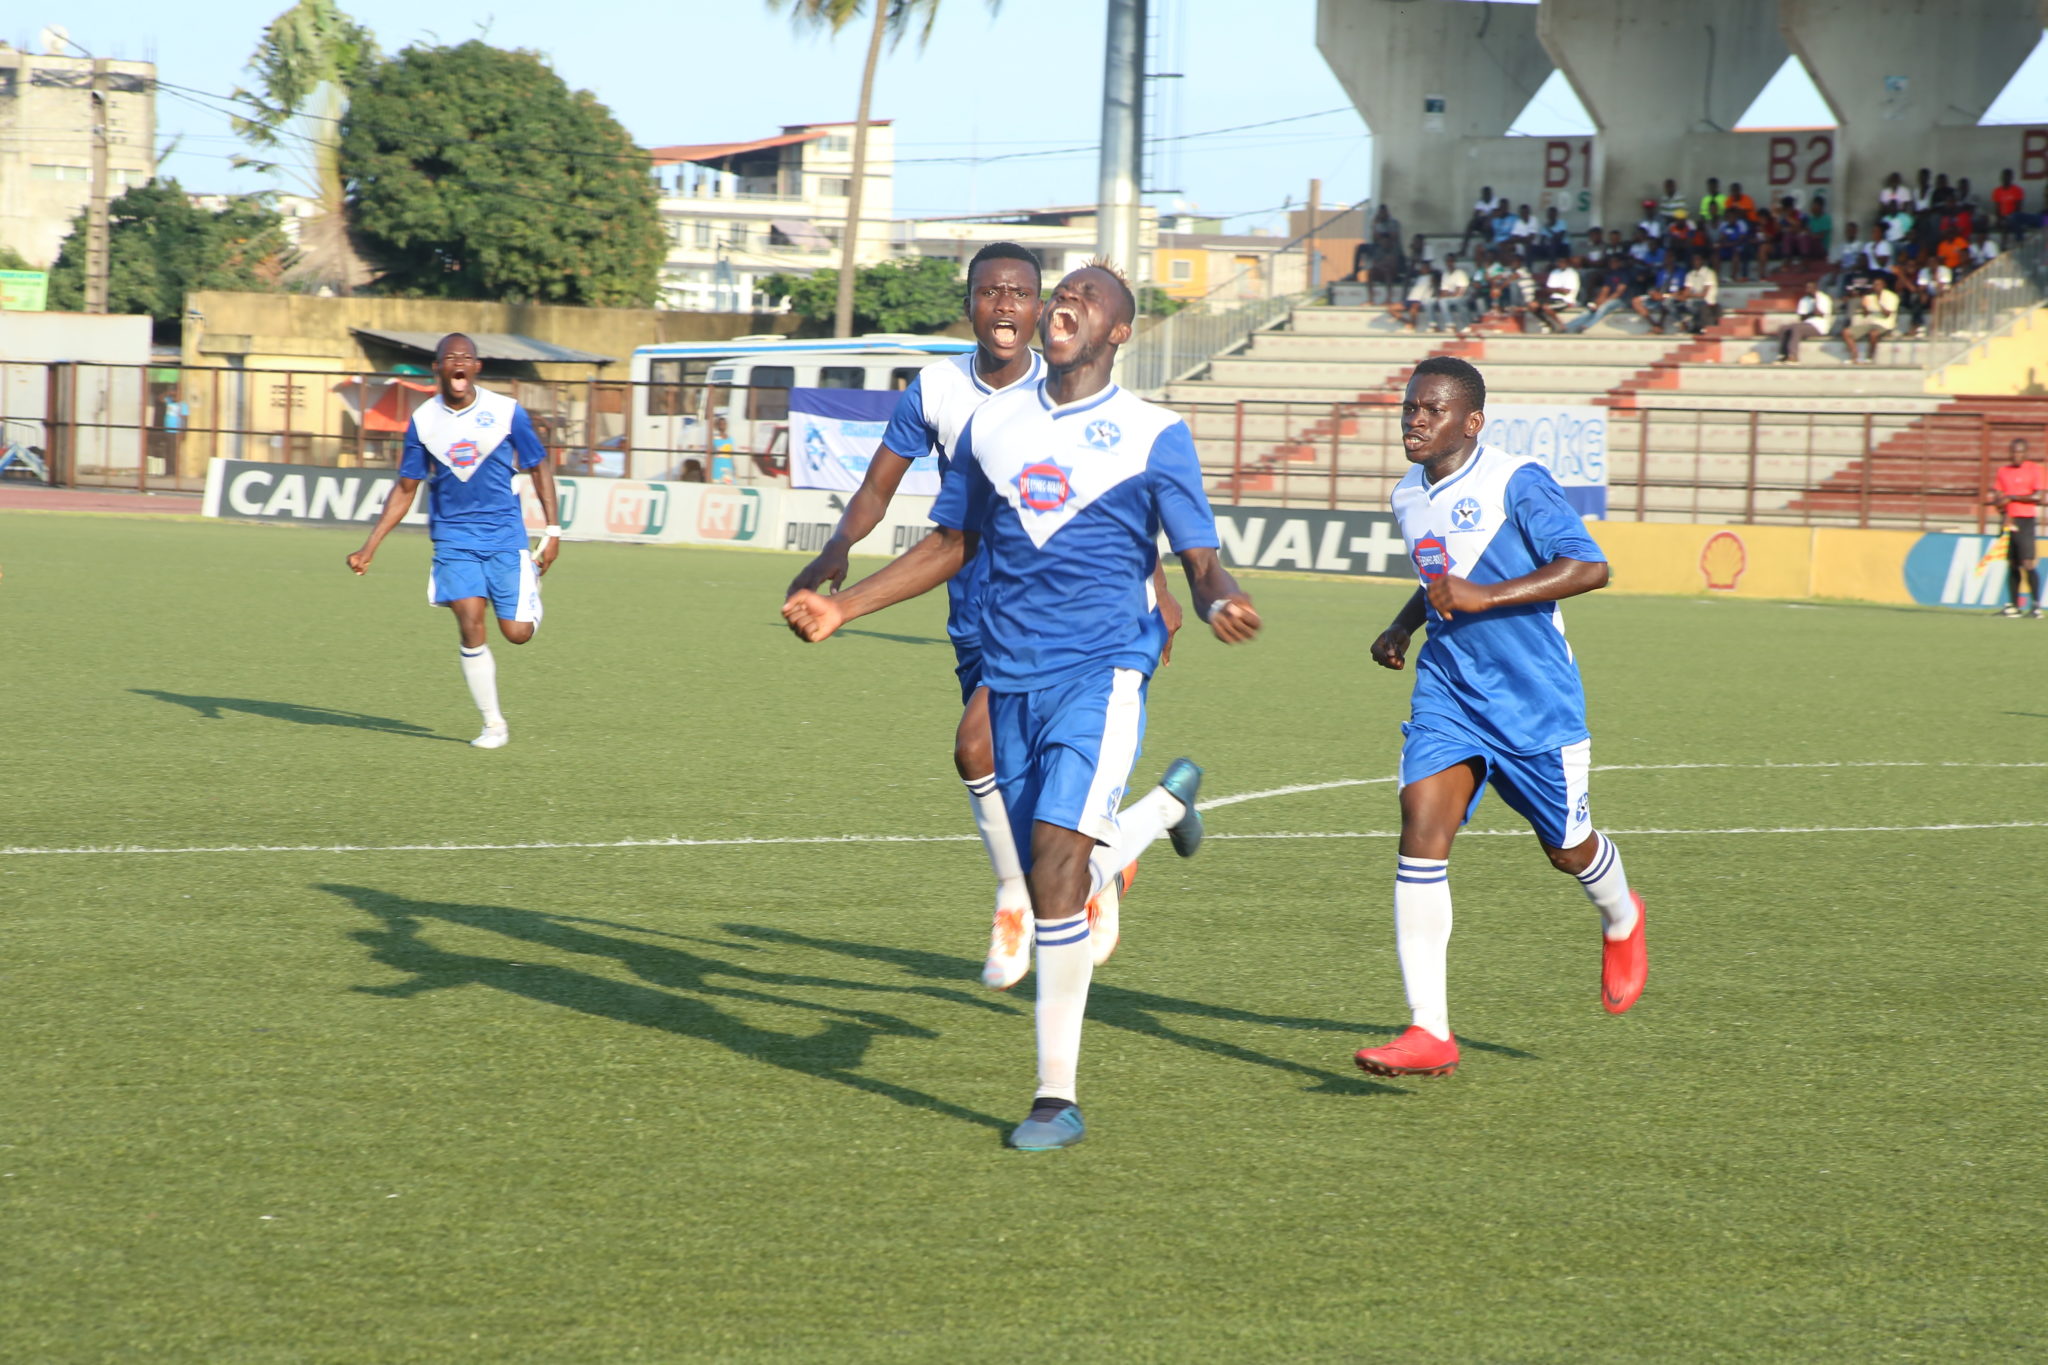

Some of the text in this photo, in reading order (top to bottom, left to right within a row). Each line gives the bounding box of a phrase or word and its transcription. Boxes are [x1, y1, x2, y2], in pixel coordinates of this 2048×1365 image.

[1545, 141, 1591, 188] B1
[1768, 136, 1833, 185] B2
[785, 521, 837, 552] PUM
[1157, 515, 1407, 573] NAL+
